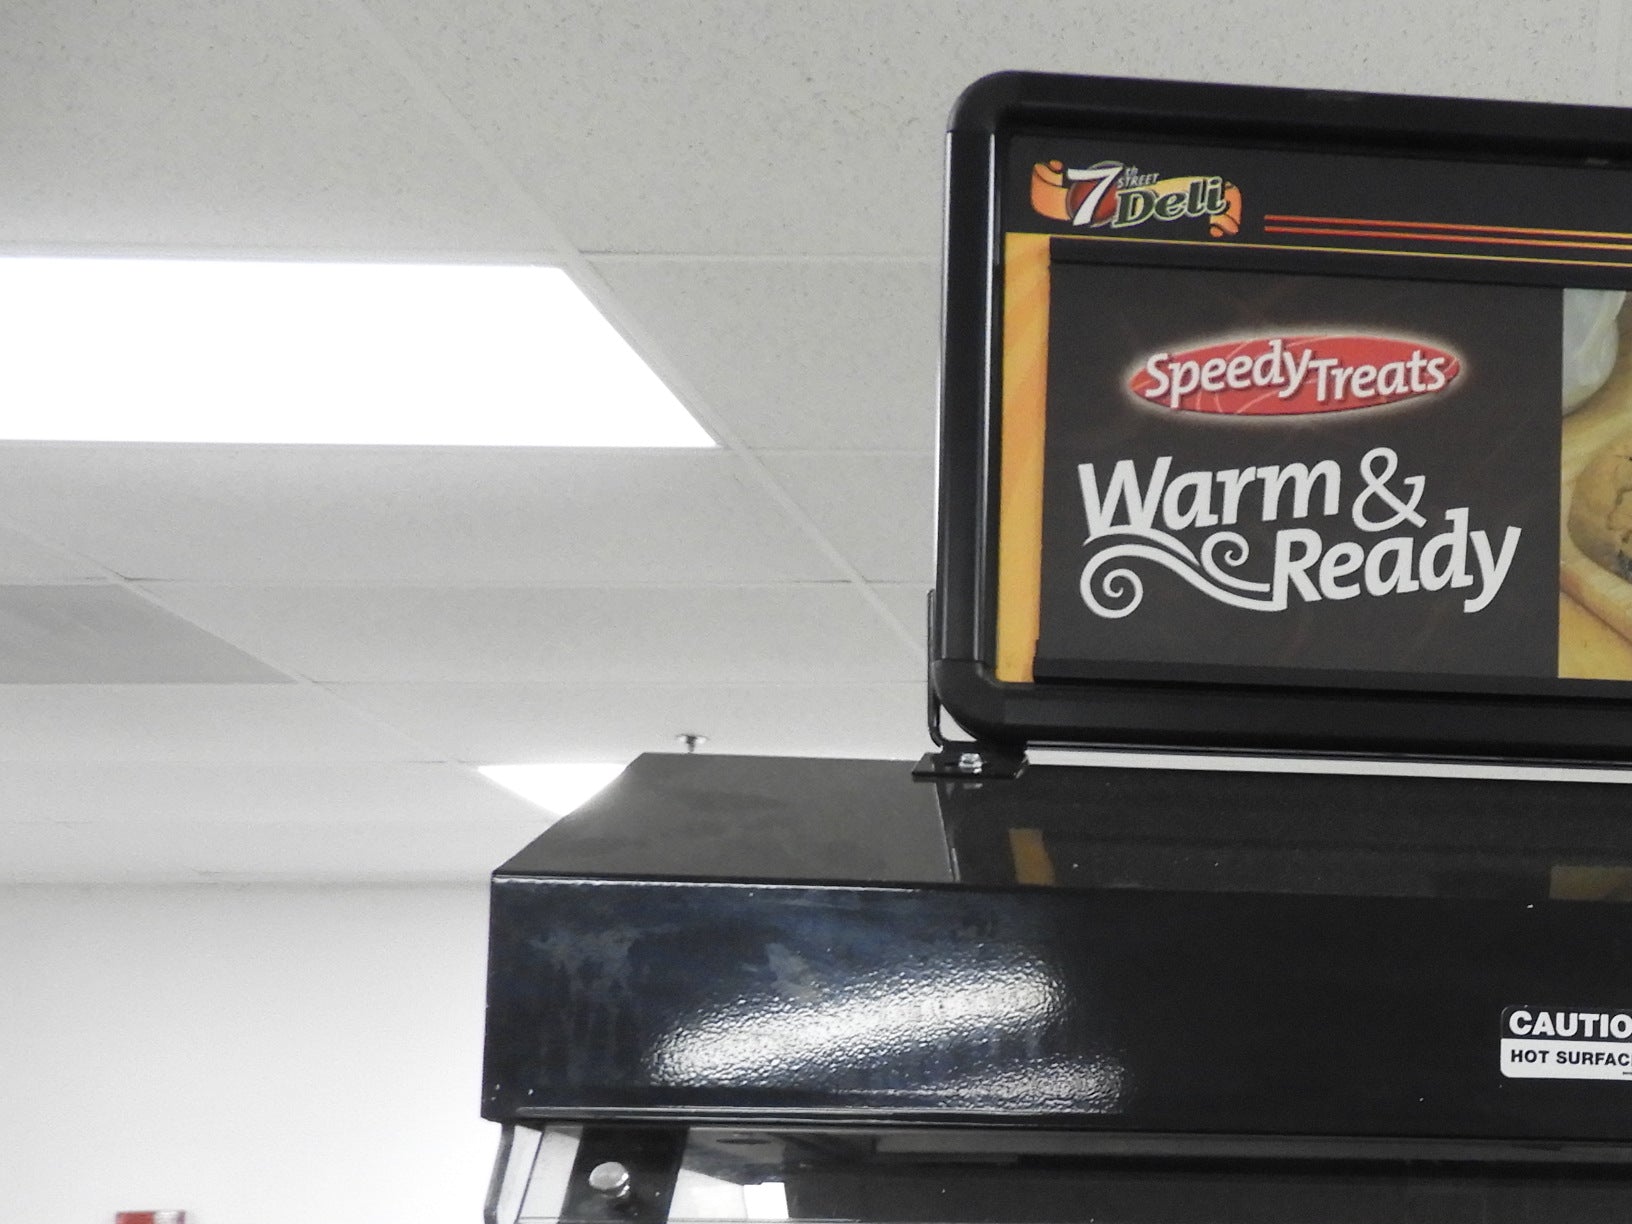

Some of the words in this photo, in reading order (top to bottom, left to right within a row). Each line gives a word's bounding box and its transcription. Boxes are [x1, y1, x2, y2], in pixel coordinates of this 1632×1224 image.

[1111, 176, 1229, 228] Deli
[1118, 172, 1160, 188] STREET
[1077, 455, 1341, 547] Warm
[1352, 446, 1427, 532] &
[1272, 506, 1522, 614] Ready
[1511, 1049, 1550, 1064] HOT
